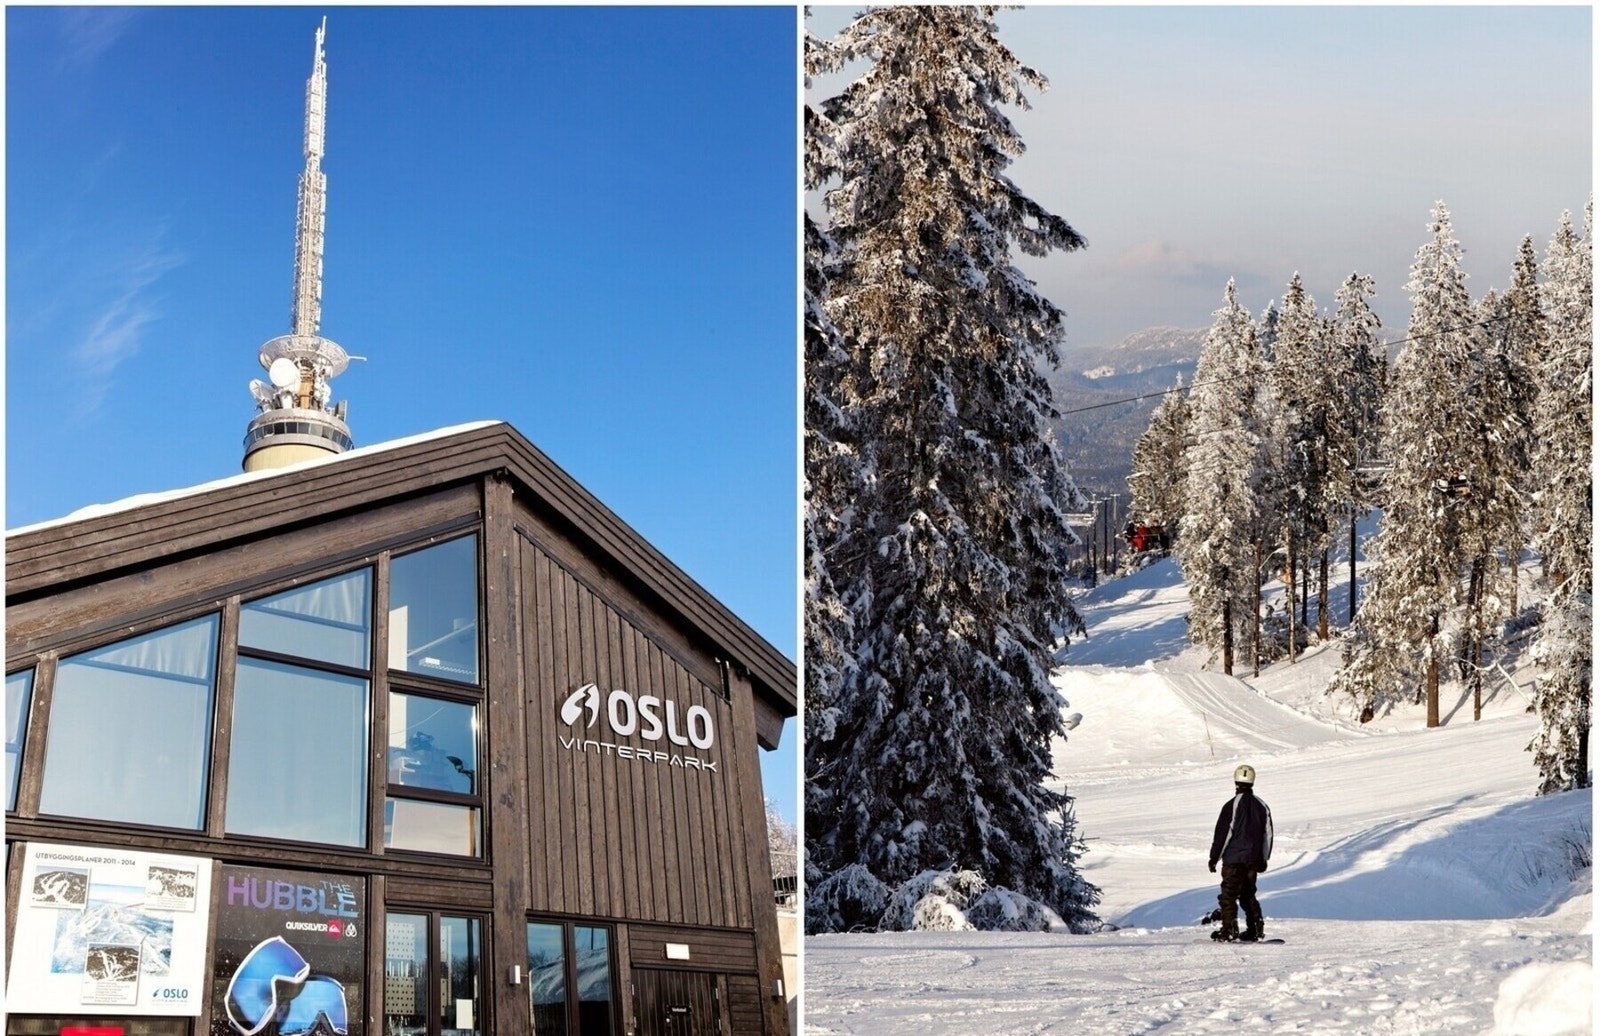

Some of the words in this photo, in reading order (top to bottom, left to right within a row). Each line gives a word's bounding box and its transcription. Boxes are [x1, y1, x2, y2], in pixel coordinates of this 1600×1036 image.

[608, 689, 714, 750] OSLO
[559, 735, 718, 773] VINTERPARK
[35, 852, 102, 863] UTBYGGINGSPLANER
[320, 880, 354, 896] THE
[227, 876, 360, 918] HUBBLE
[285, 921, 328, 932] QUIKSILVER
[163, 988, 188, 999] OSLO
